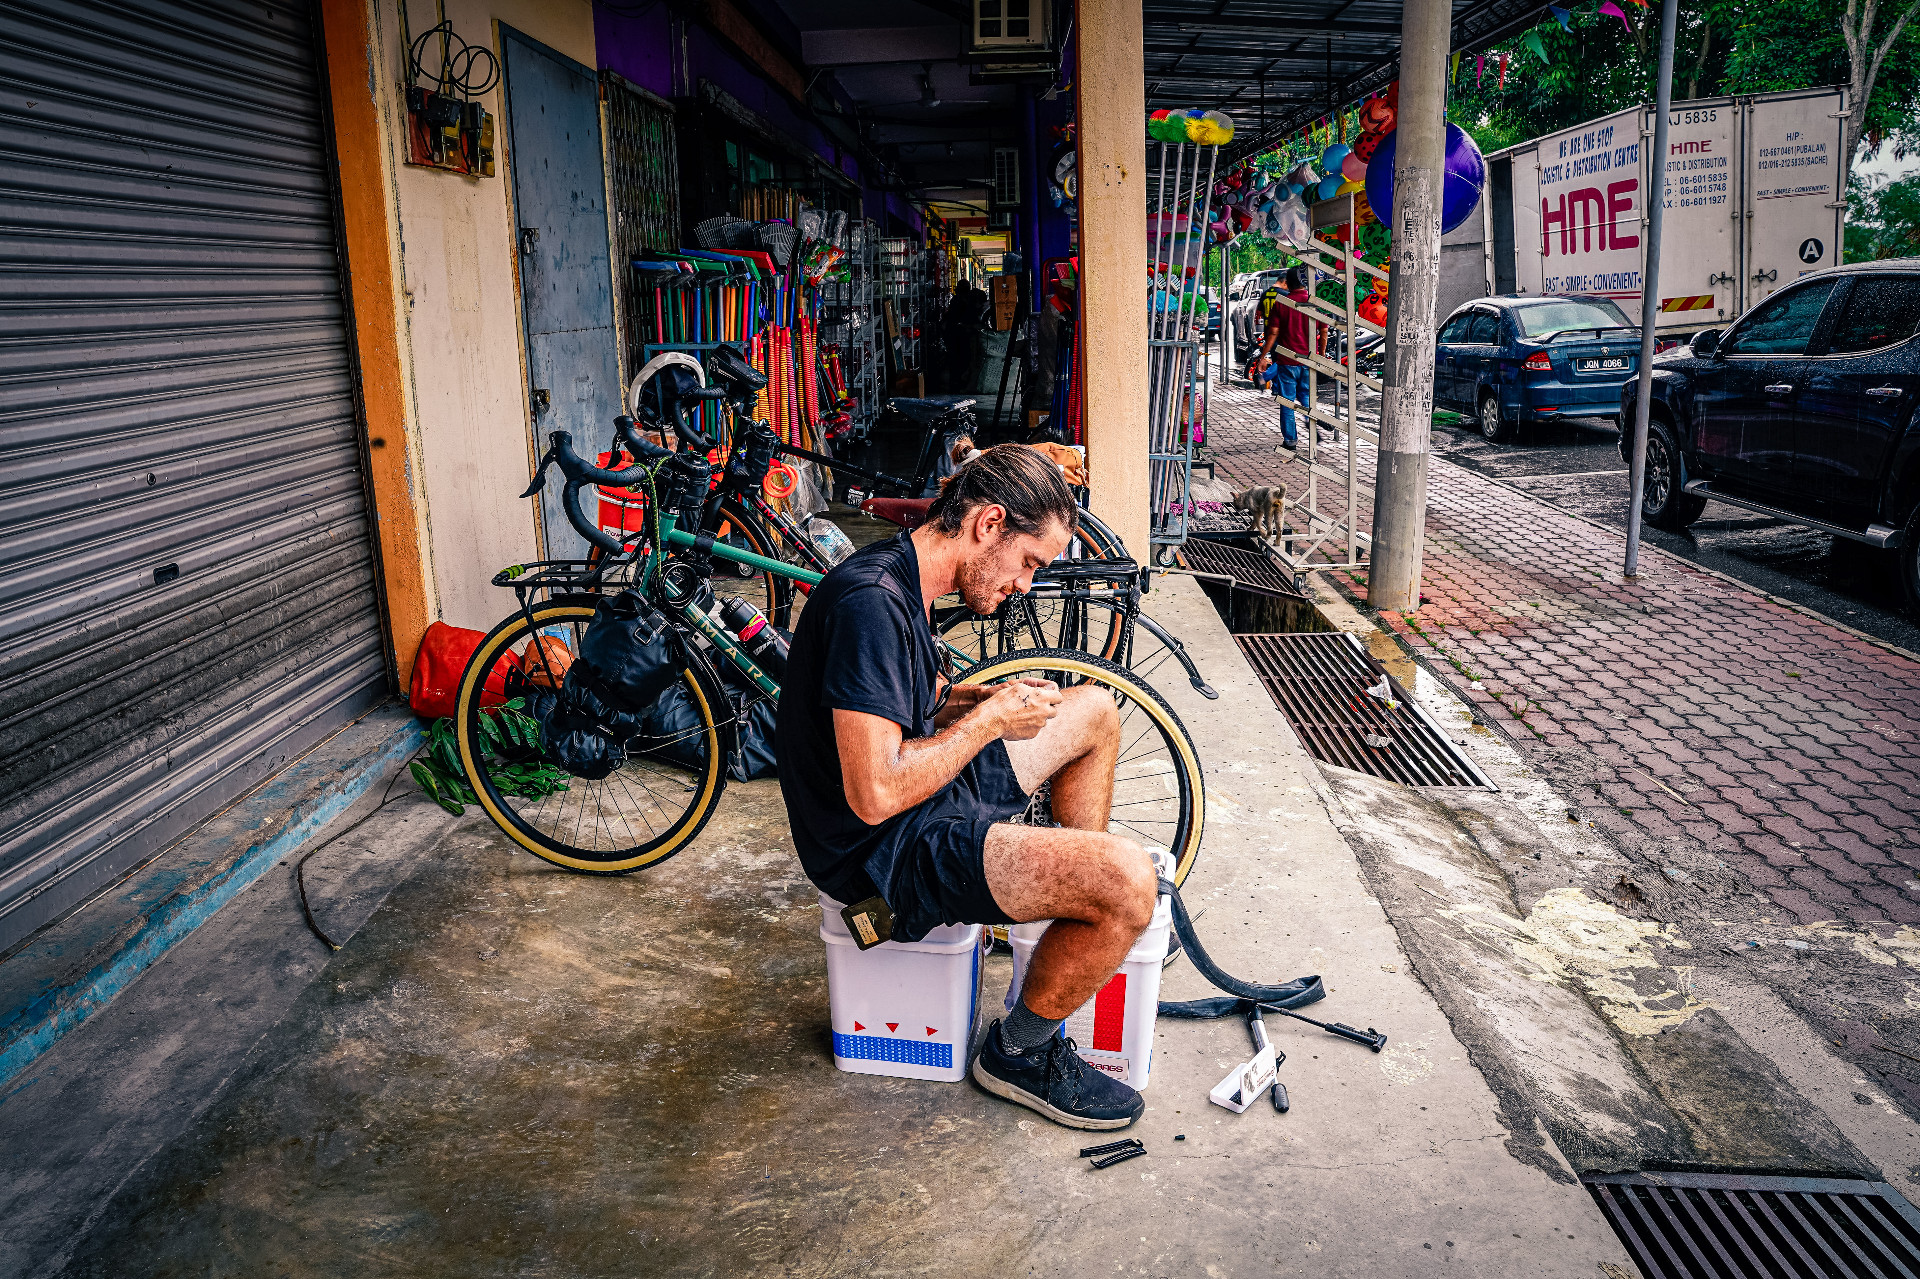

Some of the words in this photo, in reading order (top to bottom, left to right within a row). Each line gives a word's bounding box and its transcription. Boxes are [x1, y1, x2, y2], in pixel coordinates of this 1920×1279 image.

[1685, 110, 1717, 124] 5835
[1559, 140, 1568, 160] WE
[1570, 136, 1581, 156] ARE
[1583, 131, 1595, 153] ONE
[1598, 125, 1614, 149] STOP
[1671, 140, 1712, 155] HME
[1573, 150, 1612, 178] DISTRIBUTION
[1614, 143, 1639, 168] CENTRE
[1688, 156, 1728, 170] DISTRIBUTION
[1542, 178, 1640, 257] HME
[1802, 240, 1820, 260] A
[1545, 276, 1560, 293] FAST
[1565, 275, 1588, 292] SIMPLE
[1593, 271, 1639, 291] CONVENIENT
